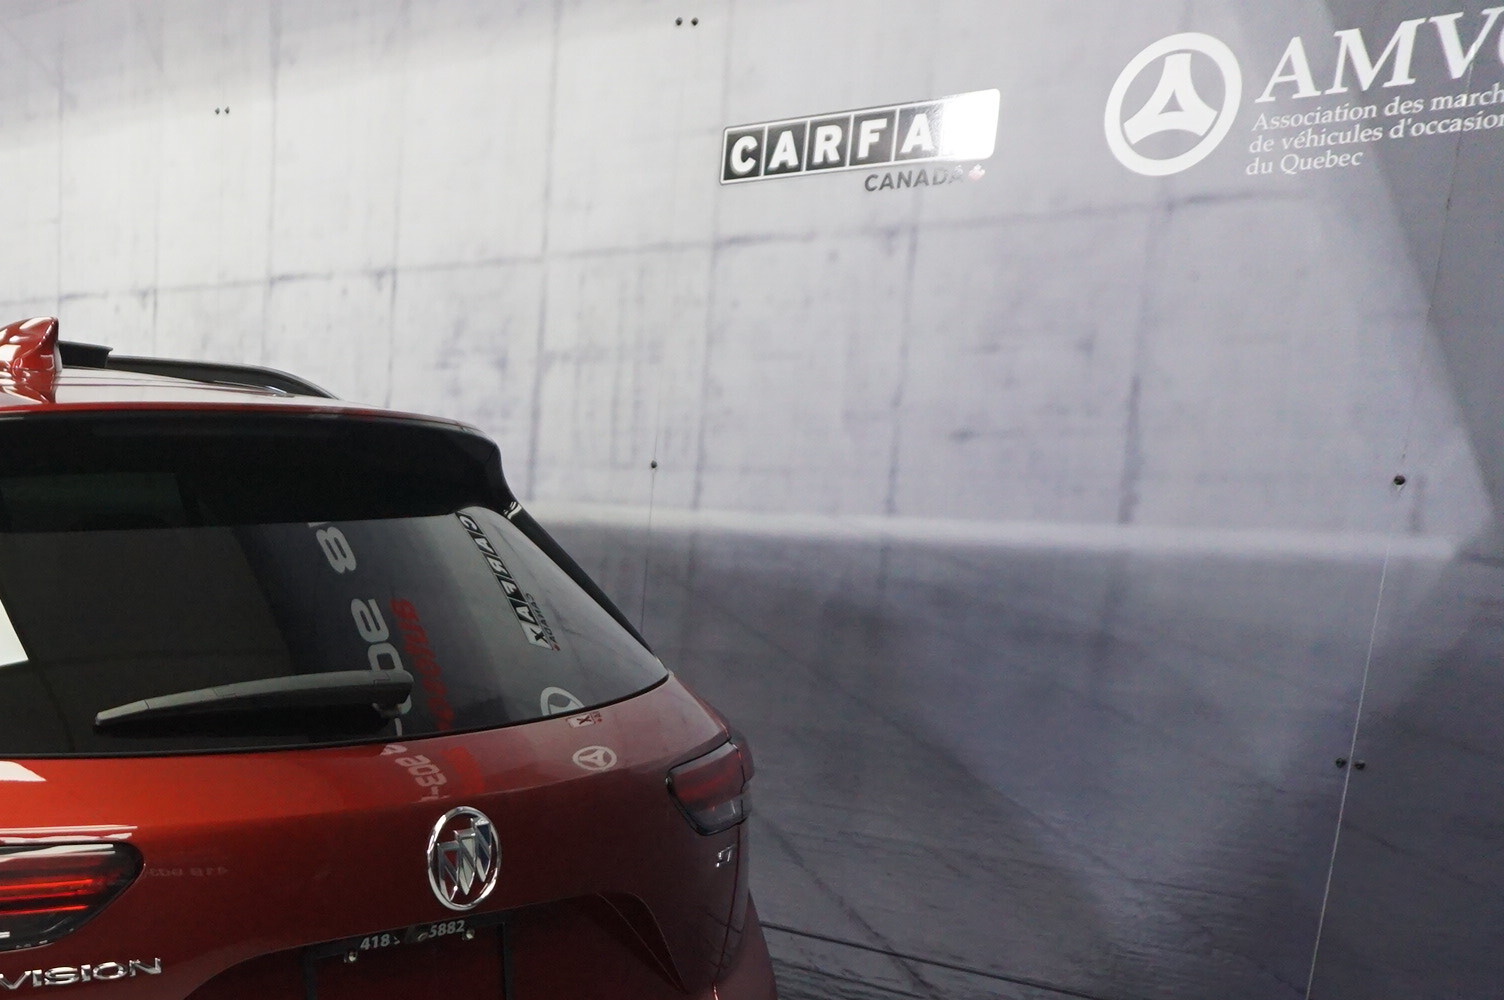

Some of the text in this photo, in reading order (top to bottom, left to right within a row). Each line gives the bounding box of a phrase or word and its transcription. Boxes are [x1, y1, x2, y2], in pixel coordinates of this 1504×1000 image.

[1255, 6, 1504, 103] AMV
[1251, 103, 1377, 132] Association
[1384, 93, 1424, 117] des
[729, 98, 994, 176] CARFA
[1249, 136, 1274, 154] de
[1282, 124, 1384, 150] véhicules
[1246, 158, 1273, 176] du
[360, 933, 390, 950] 418
